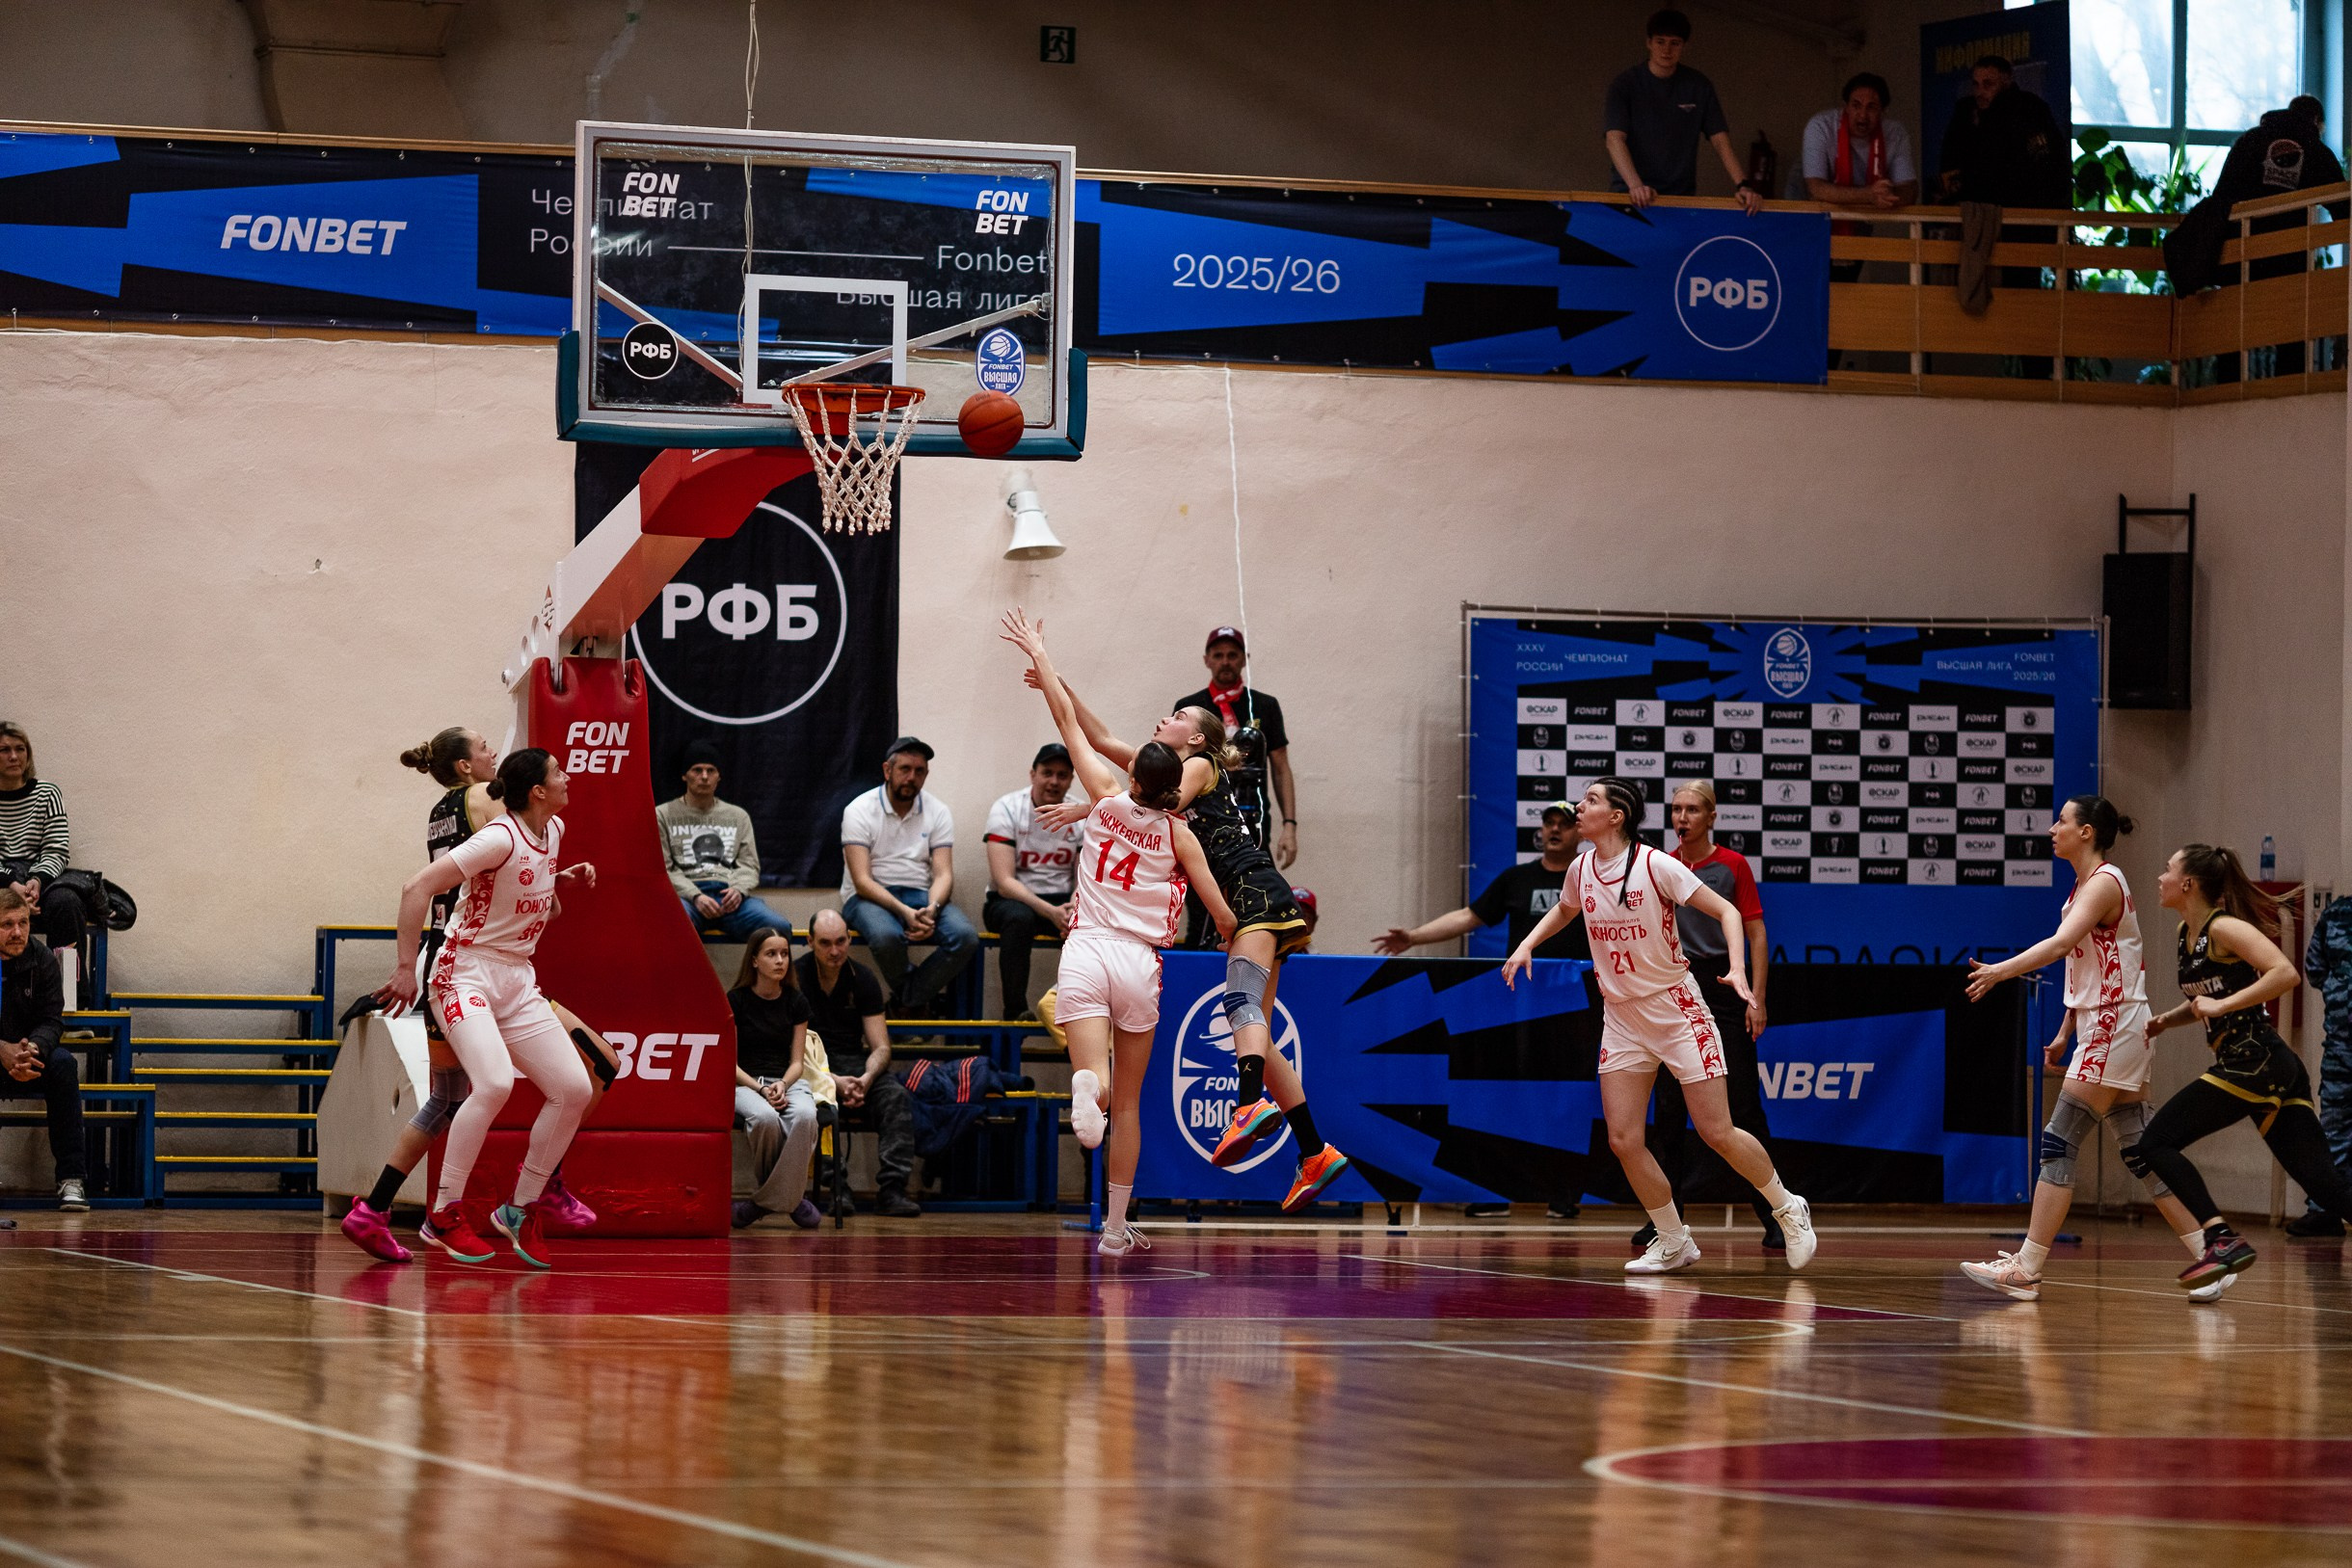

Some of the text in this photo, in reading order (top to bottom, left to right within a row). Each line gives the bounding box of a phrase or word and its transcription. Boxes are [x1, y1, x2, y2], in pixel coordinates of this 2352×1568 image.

[623, 172, 680, 195] FON
[623, 195, 678, 218] BET
[976, 190, 1029, 213] FON
[975, 213, 1029, 235] BET
[221, 214, 407, 255] FONBET
[938, 245, 1048, 274] Fonbet
[1172, 253, 1341, 294] 2025/26
[1689, 276, 1769, 309] РФБ
[629, 341, 672, 359] РФБ
[983, 371, 1018, 384] ВЫСШАЯ
[662, 583, 819, 641] РФБ
[1516, 643, 1546, 653] XXXV
[1564, 653, 1628, 664] ЧЕМПИОНАТ
[2014, 653, 2055, 663] FONBET
[1516, 661, 1564, 671] РОССИИ
[1937, 660, 2013, 672] ВЫСШАЯ ЛИГА
[2013, 672, 2056, 681] 2025/26
[1574, 706, 1608, 716] FONBET
[1672, 708, 1706, 718] FONBET
[1771, 710, 1804, 719] FONBET
[1868, 712, 1902, 722] FONBET
[1964, 713, 1998, 723] FONBET
[566, 721, 629, 747] FON
[566, 749, 629, 774] BET
[1574, 758, 1608, 768] FONBET
[1672, 760, 1706, 770] FONBET
[1770, 762, 1804, 772] FONBET
[1868, 764, 1901, 774] FONBET
[1964, 765, 1998, 775] FONBET
[1770, 813, 1804, 823] FONBET
[1867, 815, 1901, 825] FONBET
[1964, 816, 1997, 826] FONBET
[1099, 809, 1163, 851] ЧИЖЕВСКАЯ
[1094, 838, 1141, 891] 14
[1770, 865, 1804, 874] FONBET
[1867, 866, 1900, 876] FONBET
[1964, 868, 1996, 877] FONBET
[1625, 890, 1644, 899] FON
[1590, 924, 1647, 942] ЮНОСТЬ
[1610, 950, 1636, 975] 21
[601, 1031, 720, 1081] BET
[1757, 1062, 1875, 1100] NBET
